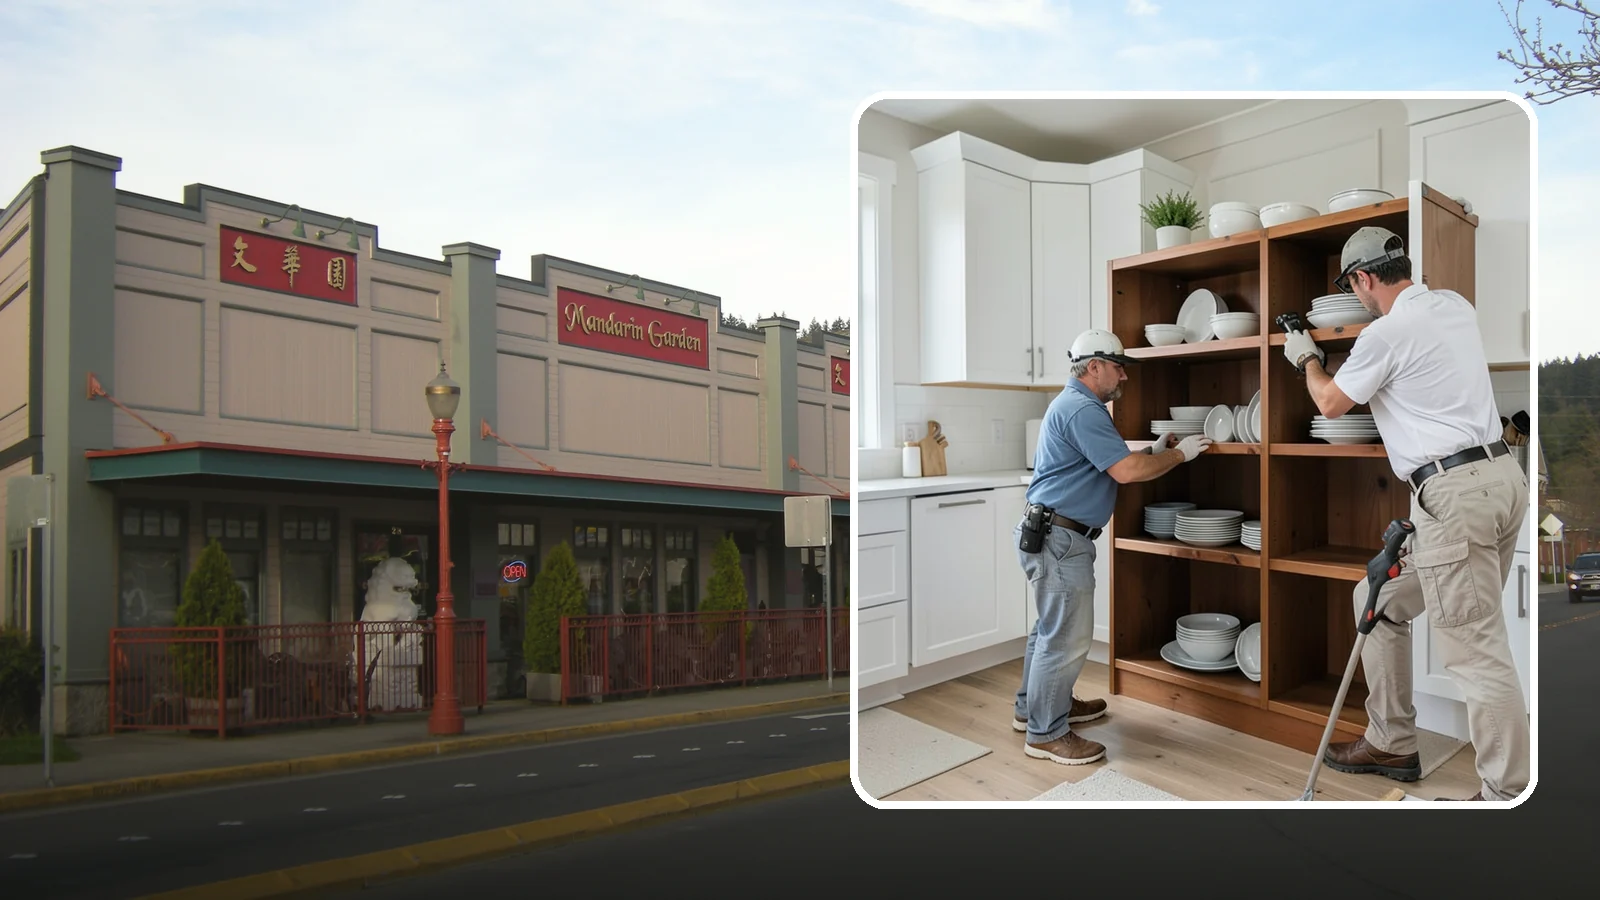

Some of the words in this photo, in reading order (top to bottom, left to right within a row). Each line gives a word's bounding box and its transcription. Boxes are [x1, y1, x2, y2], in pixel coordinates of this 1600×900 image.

[230, 235, 347, 291] 文華園
[564, 302, 644, 341] Mandarin
[647, 320, 701, 352] Garden
[503, 565, 527, 578] OPEN
